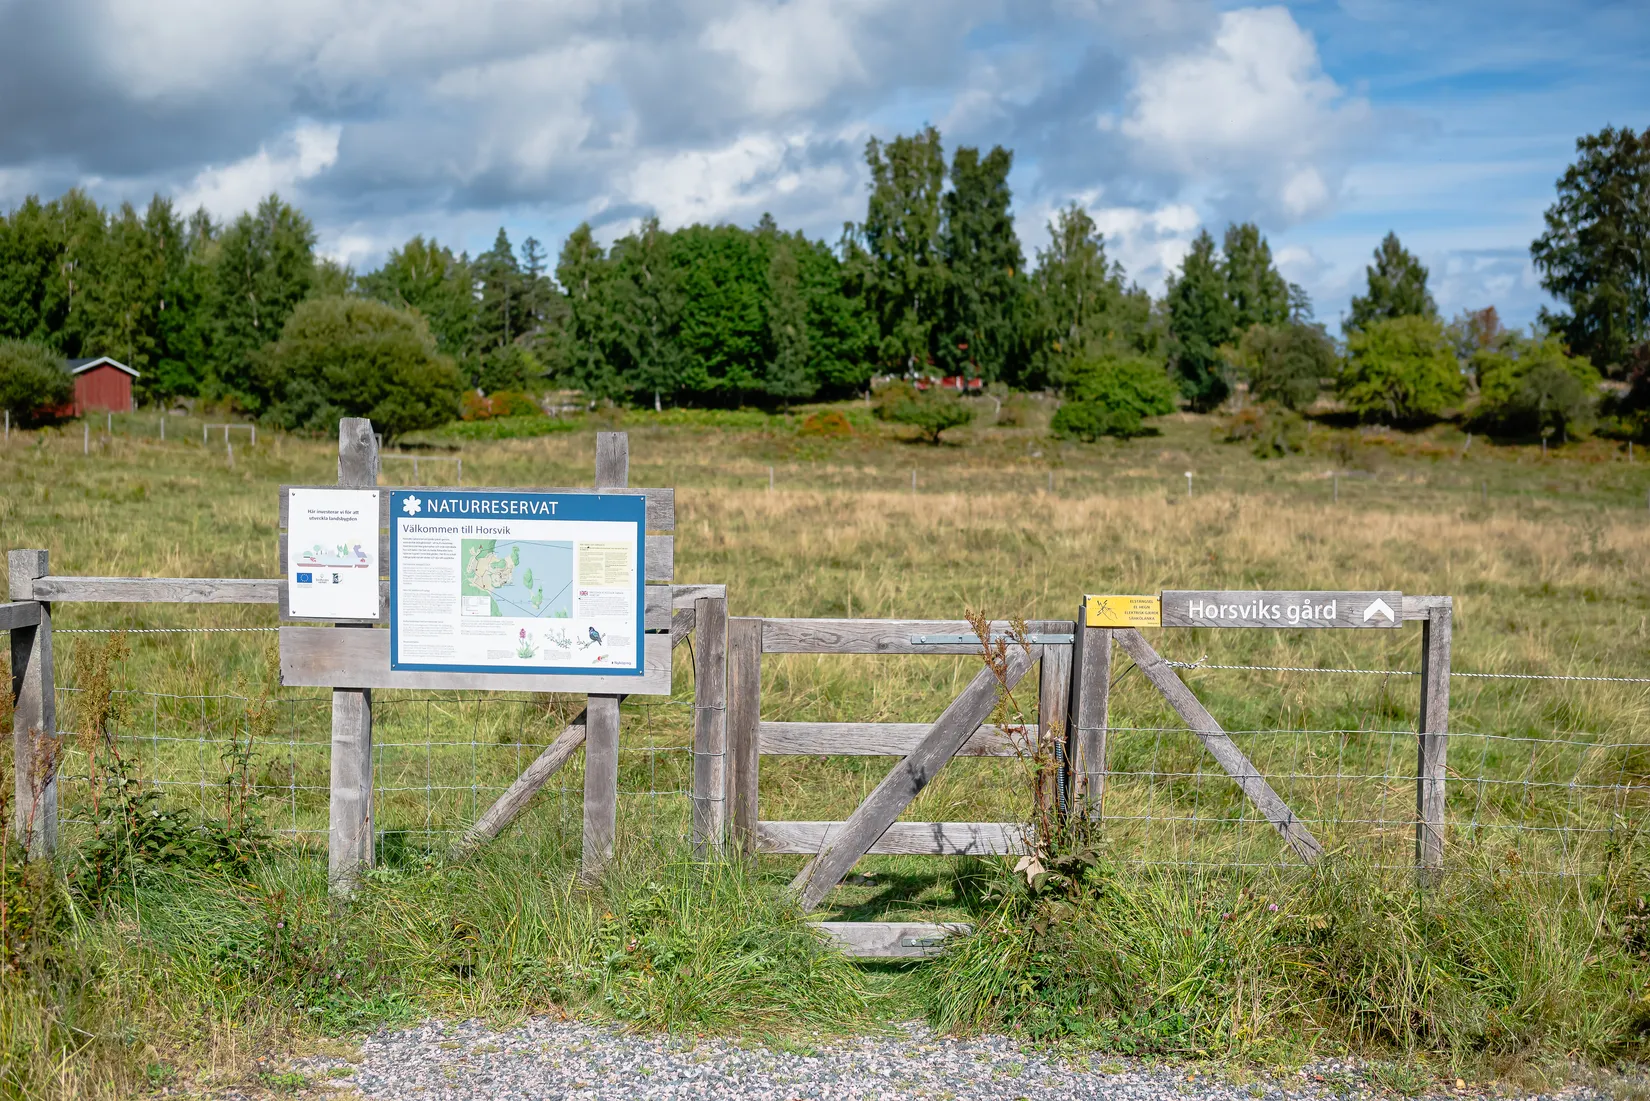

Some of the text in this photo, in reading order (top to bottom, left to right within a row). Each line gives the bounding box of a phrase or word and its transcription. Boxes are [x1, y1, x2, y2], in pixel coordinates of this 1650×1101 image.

[427, 499, 558, 515] NATURRESERVAT
[402, 524, 511, 535] Välkommen till Horsvik
[1188, 598, 1337, 625] Horsviks gård
